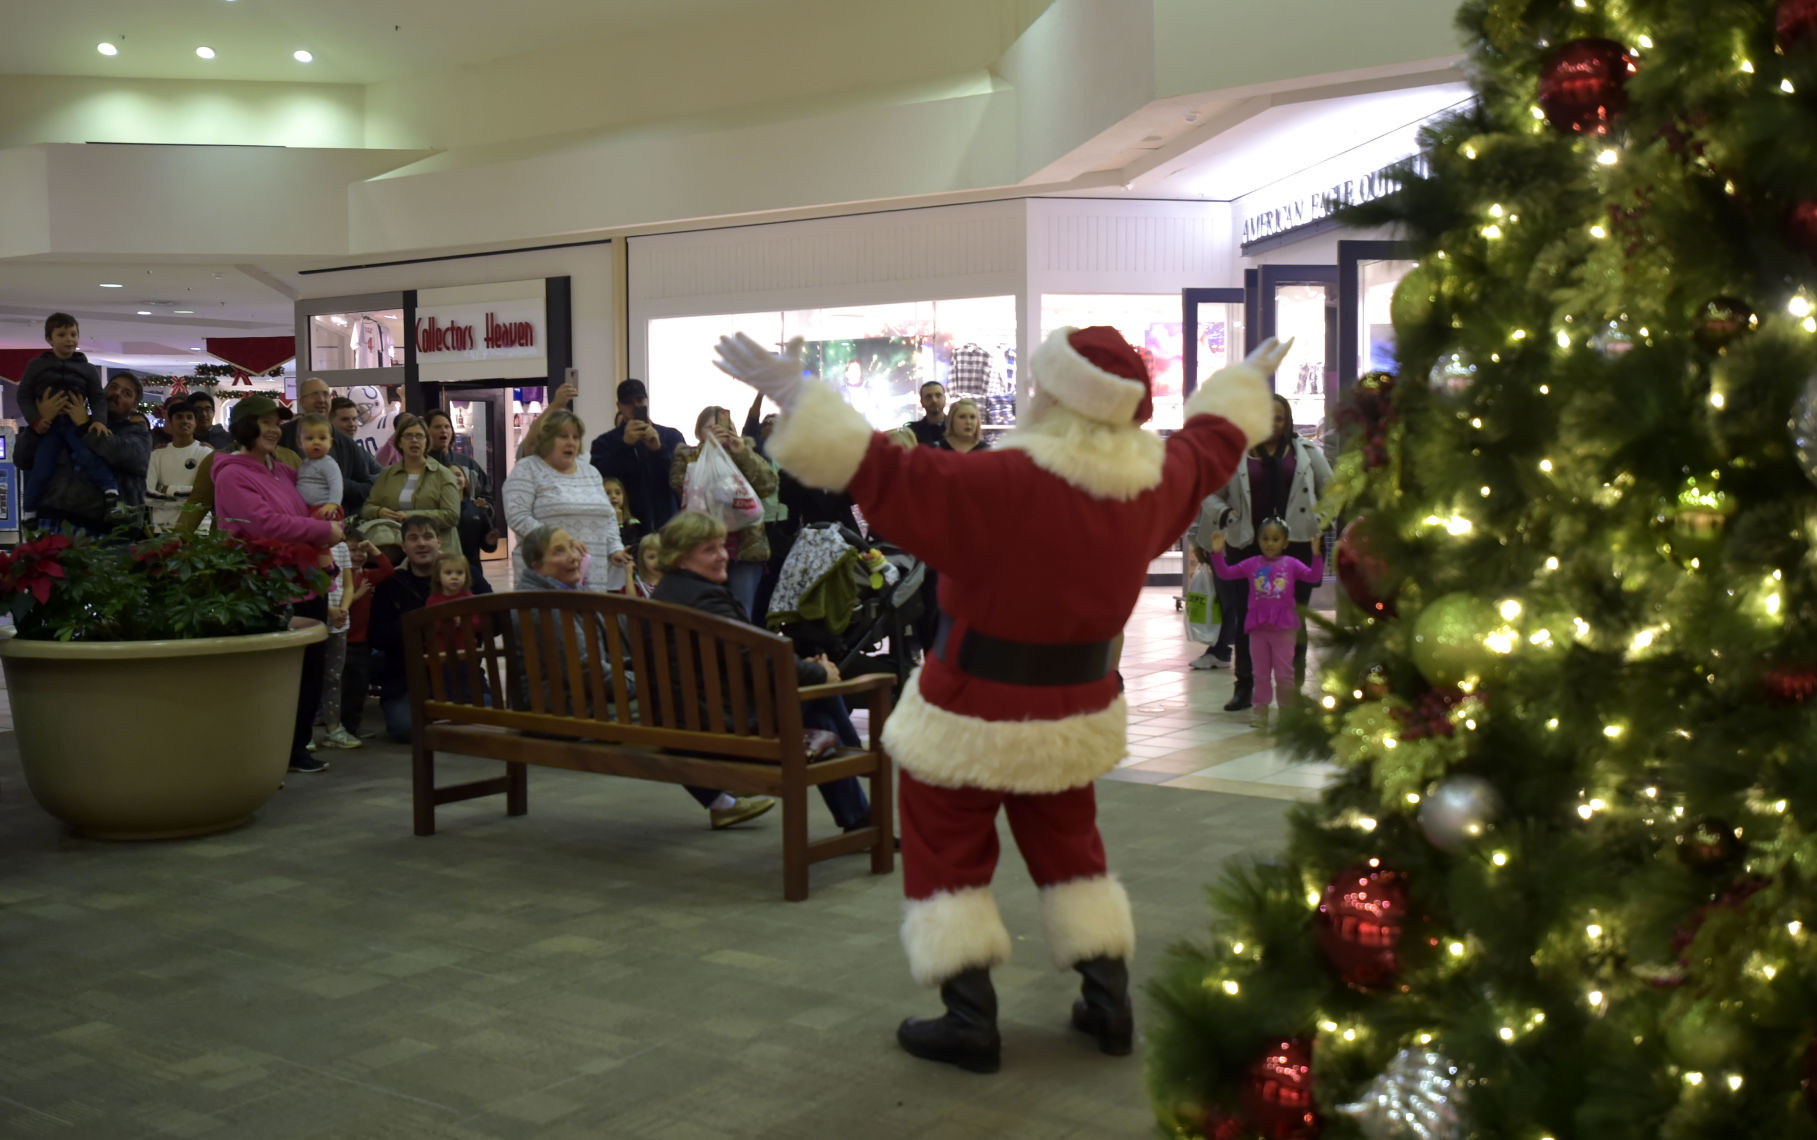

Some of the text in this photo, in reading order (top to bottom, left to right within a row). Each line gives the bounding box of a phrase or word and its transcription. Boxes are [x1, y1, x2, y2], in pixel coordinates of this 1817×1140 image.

[1241, 199, 1304, 242] AMERICAN
[415, 312, 534, 352] Collectors Heaven
